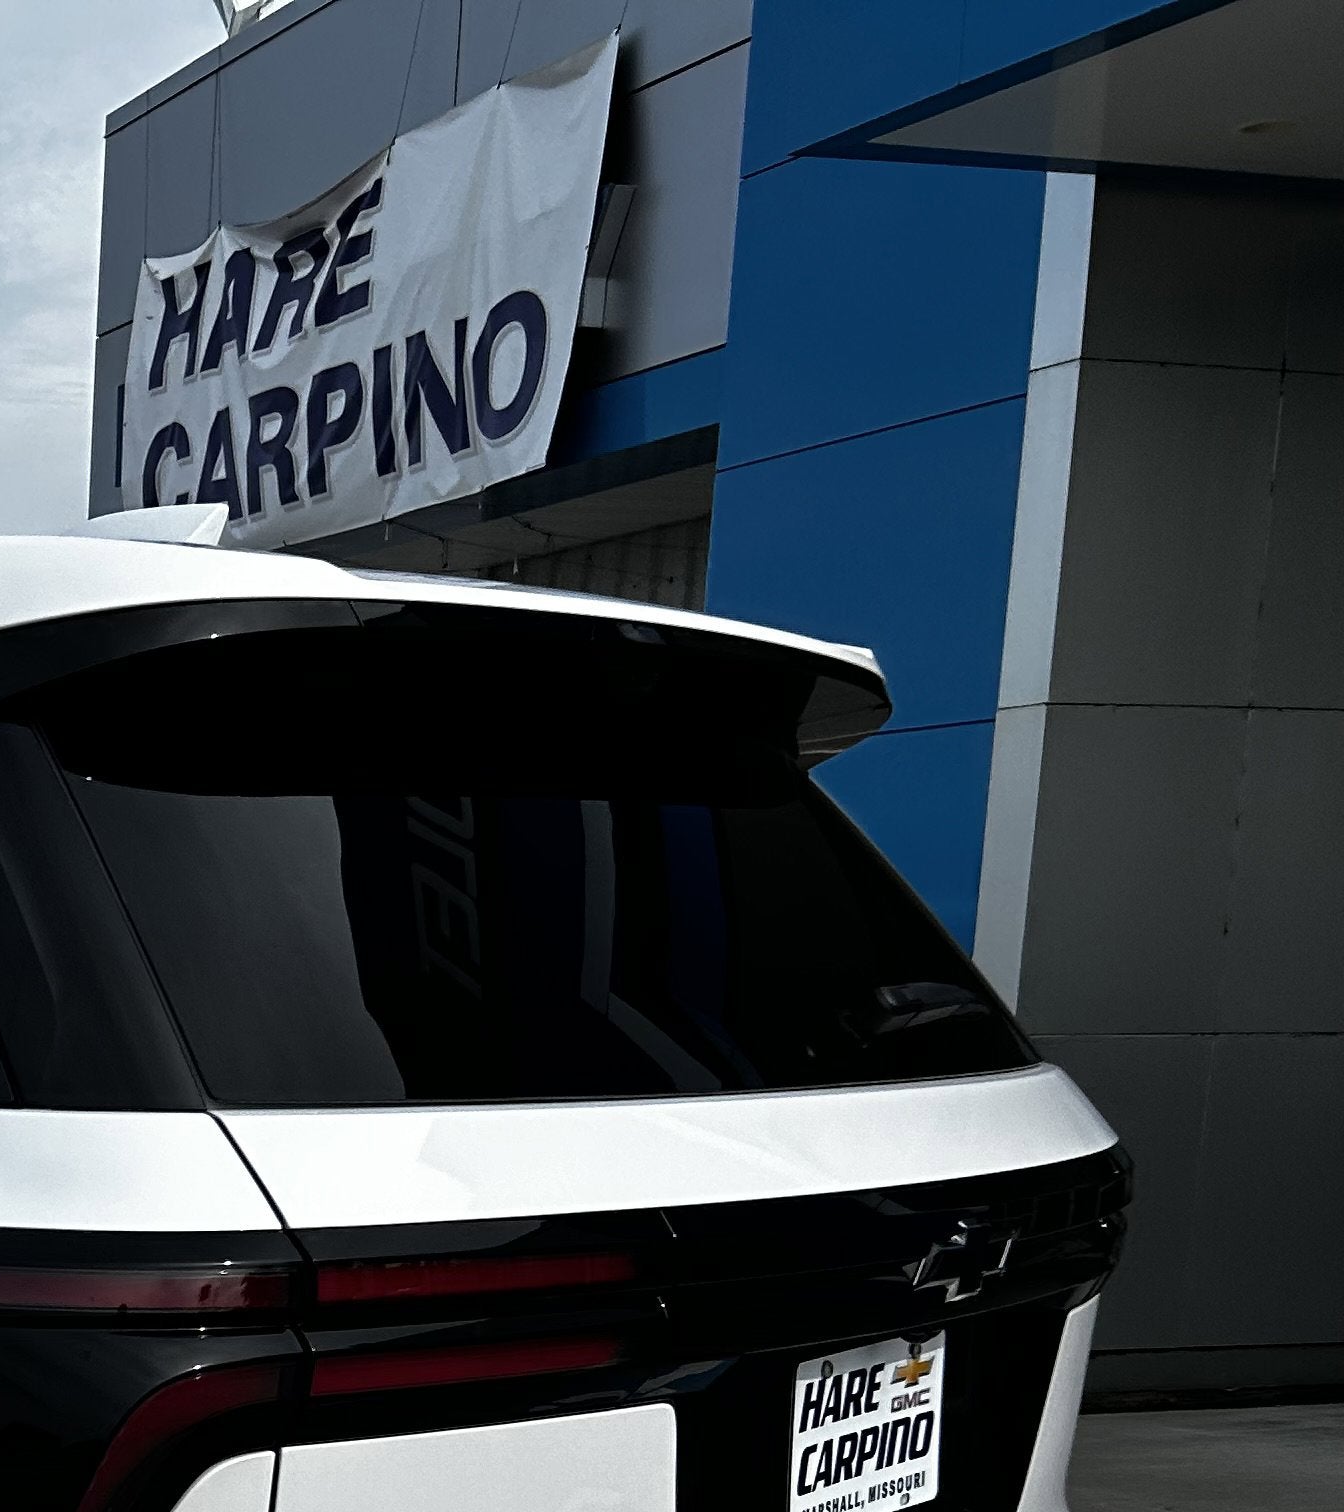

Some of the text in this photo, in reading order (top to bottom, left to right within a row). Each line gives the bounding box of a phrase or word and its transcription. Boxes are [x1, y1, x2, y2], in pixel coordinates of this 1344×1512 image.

[148, 177, 384, 391] HARE
[142, 290, 547, 523] CARPINO
[798, 1362, 886, 1434] HARE
[891, 1387, 931, 1414] GMC
[796, 1410, 935, 1497] CARPINO
[868, 1470, 926, 1503] MISSOURI
